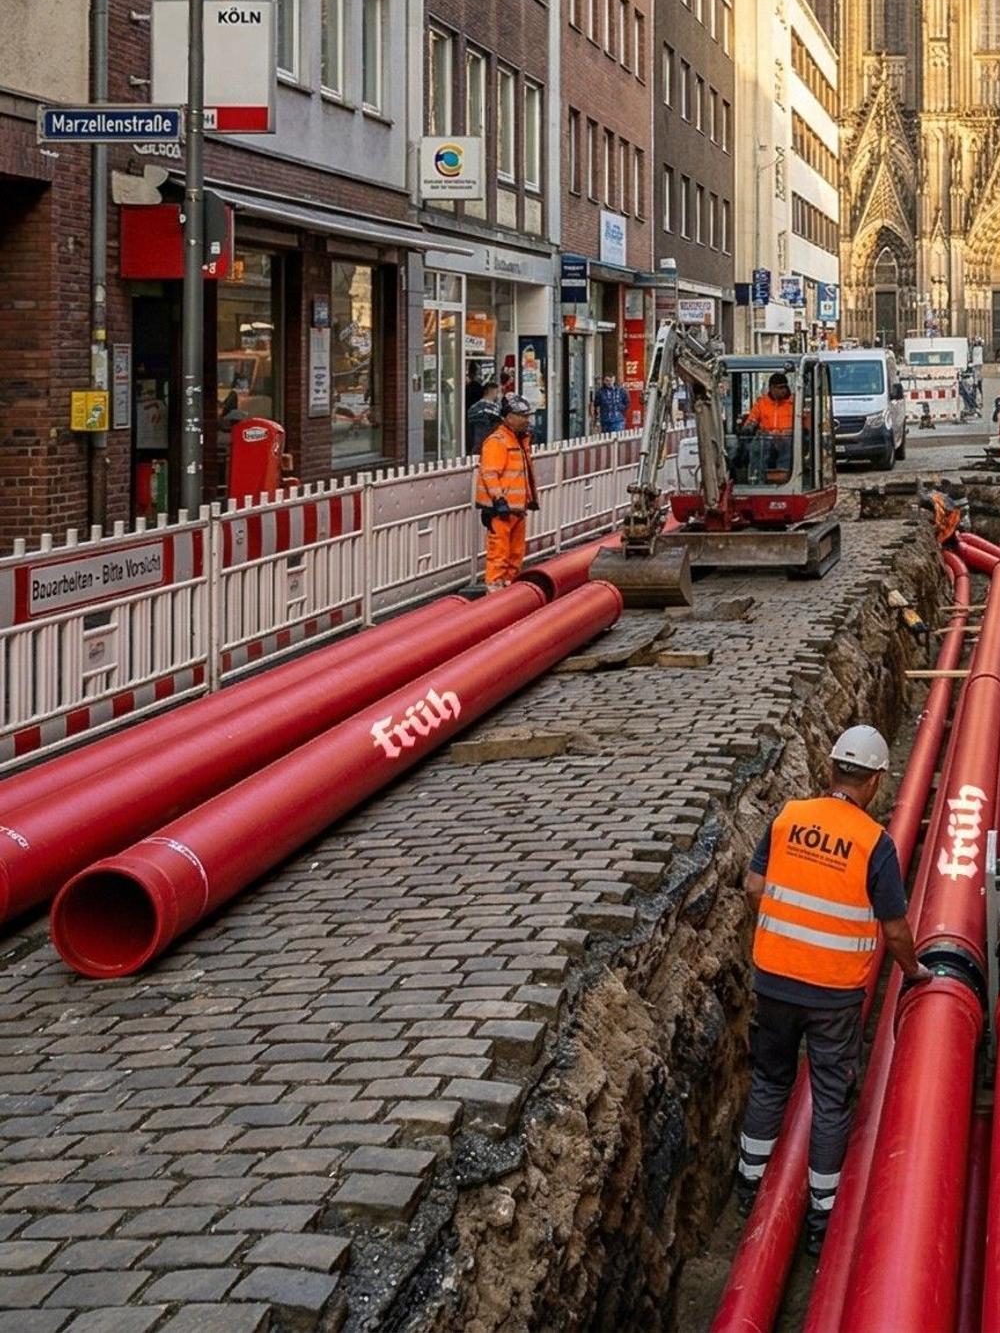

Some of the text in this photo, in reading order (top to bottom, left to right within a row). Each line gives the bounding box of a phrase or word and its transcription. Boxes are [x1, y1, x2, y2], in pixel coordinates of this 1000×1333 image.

[217, 7, 262, 24] KÖLN
[51, 114, 173, 133] Marzellenstraße
[788, 824, 853, 860] KÖLN
